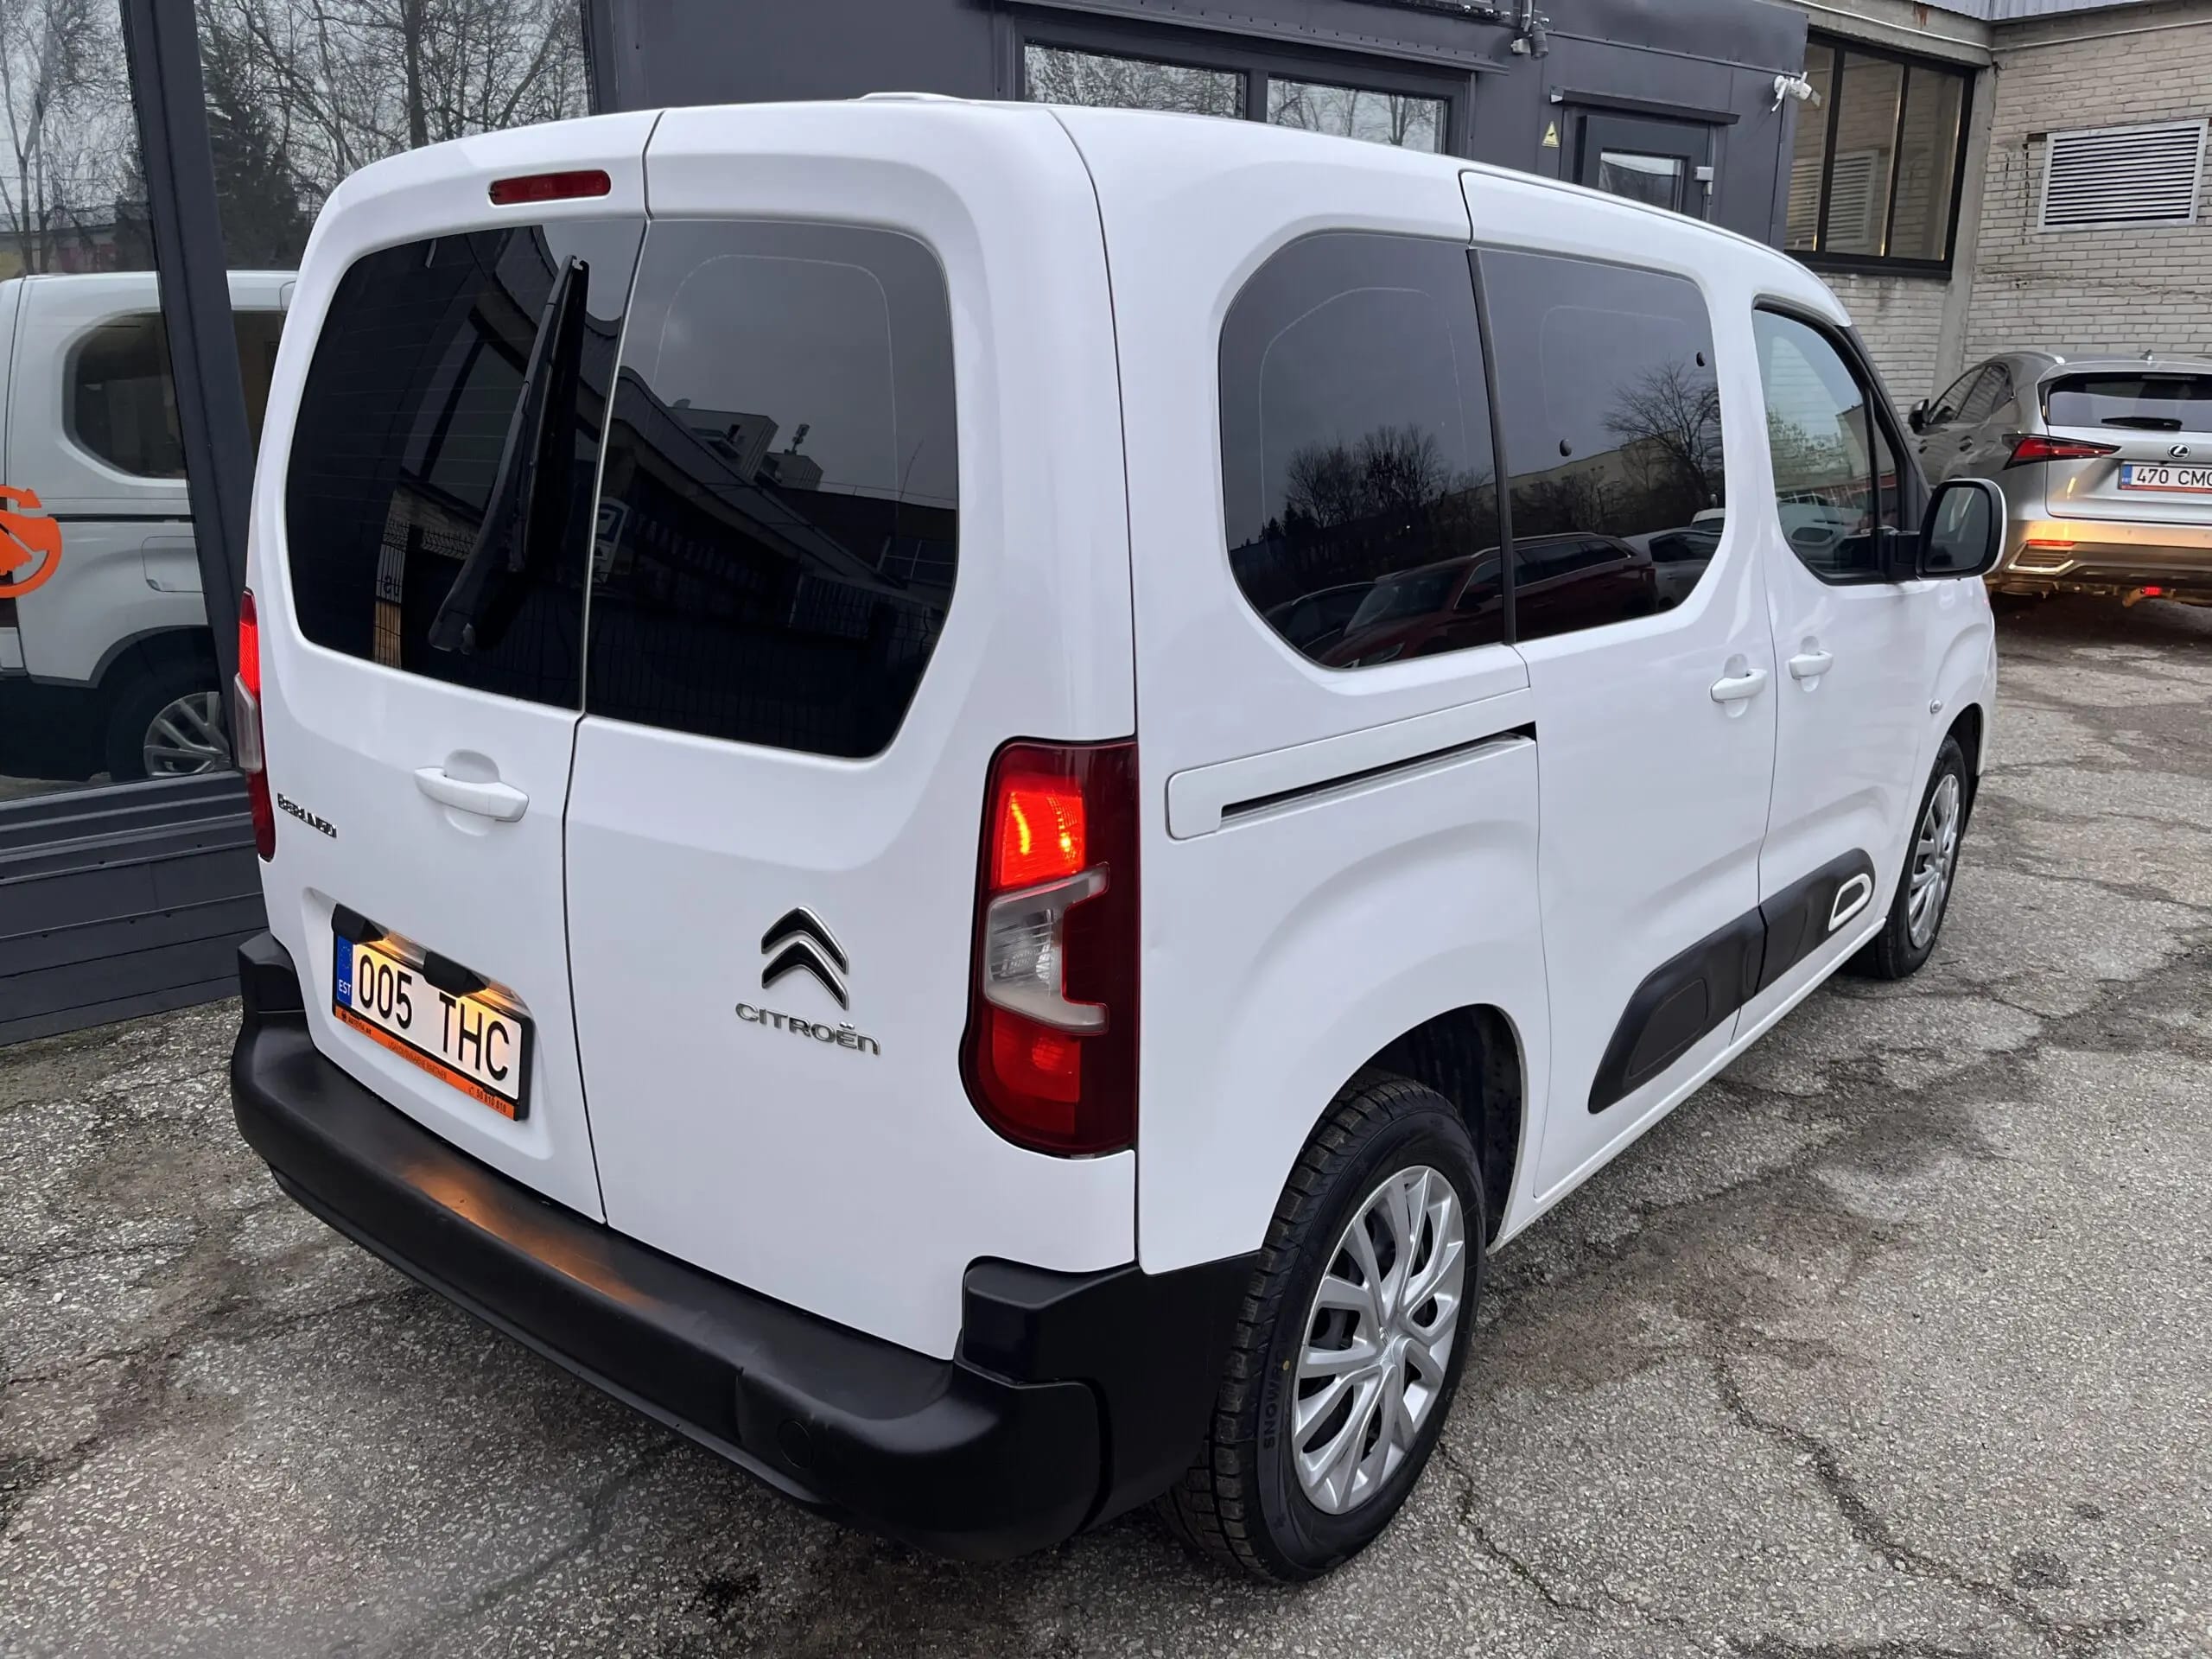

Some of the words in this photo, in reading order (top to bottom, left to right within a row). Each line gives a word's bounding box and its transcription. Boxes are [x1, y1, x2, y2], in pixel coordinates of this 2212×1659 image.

[2137, 468, 2170, 484] 470
[339, 979, 351, 996] EST
[359, 954, 413, 1030] 005
[439, 991, 511, 1082] THC
[735, 1001, 881, 1056] CITROËN
